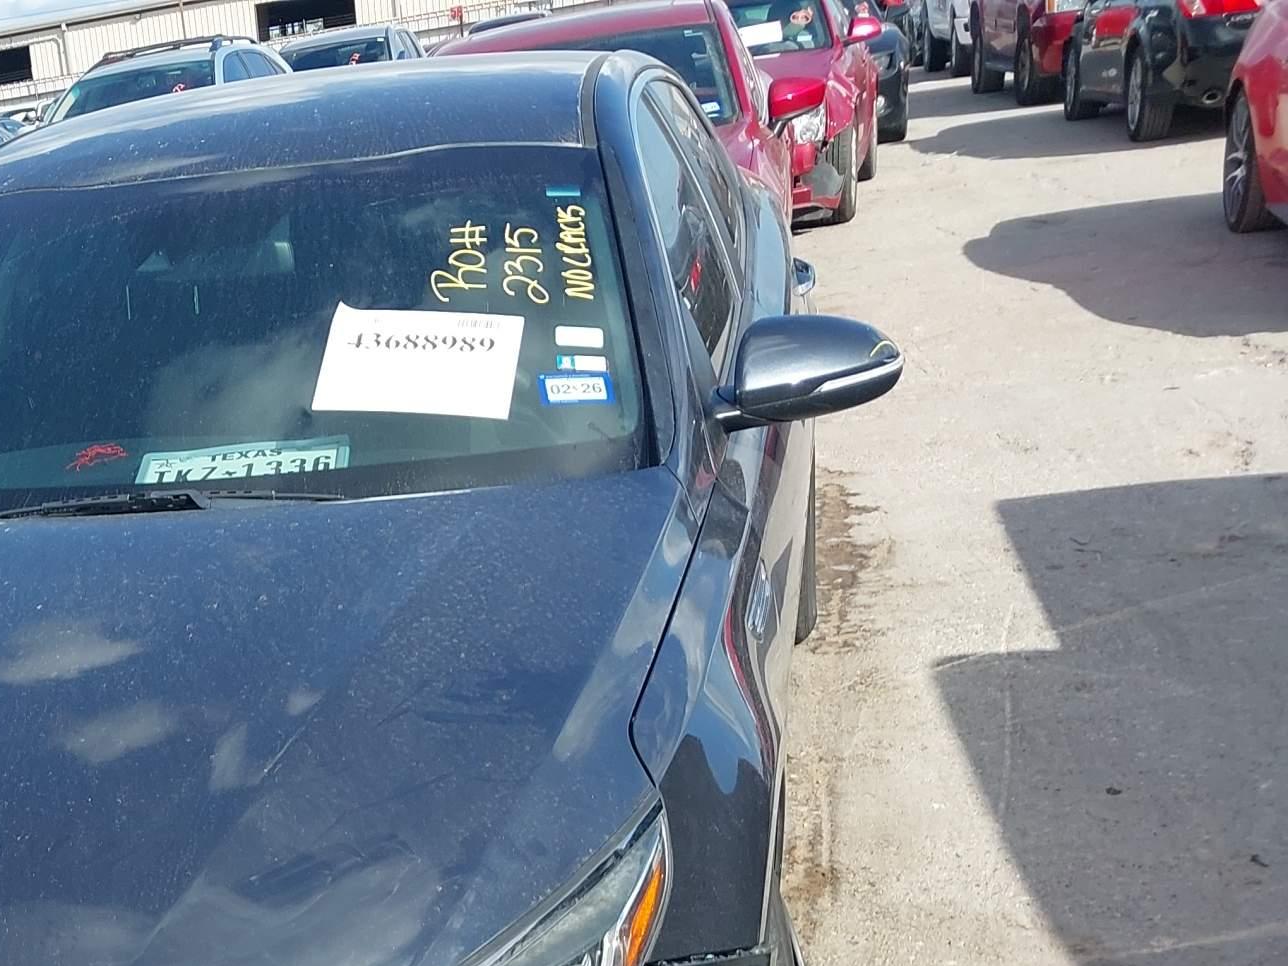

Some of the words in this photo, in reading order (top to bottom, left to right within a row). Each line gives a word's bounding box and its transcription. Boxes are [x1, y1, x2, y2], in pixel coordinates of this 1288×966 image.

[502, 222, 549, 304] 2315
[347, 332, 496, 352] 43688989
[209, 448, 283, 463] TEXAS
